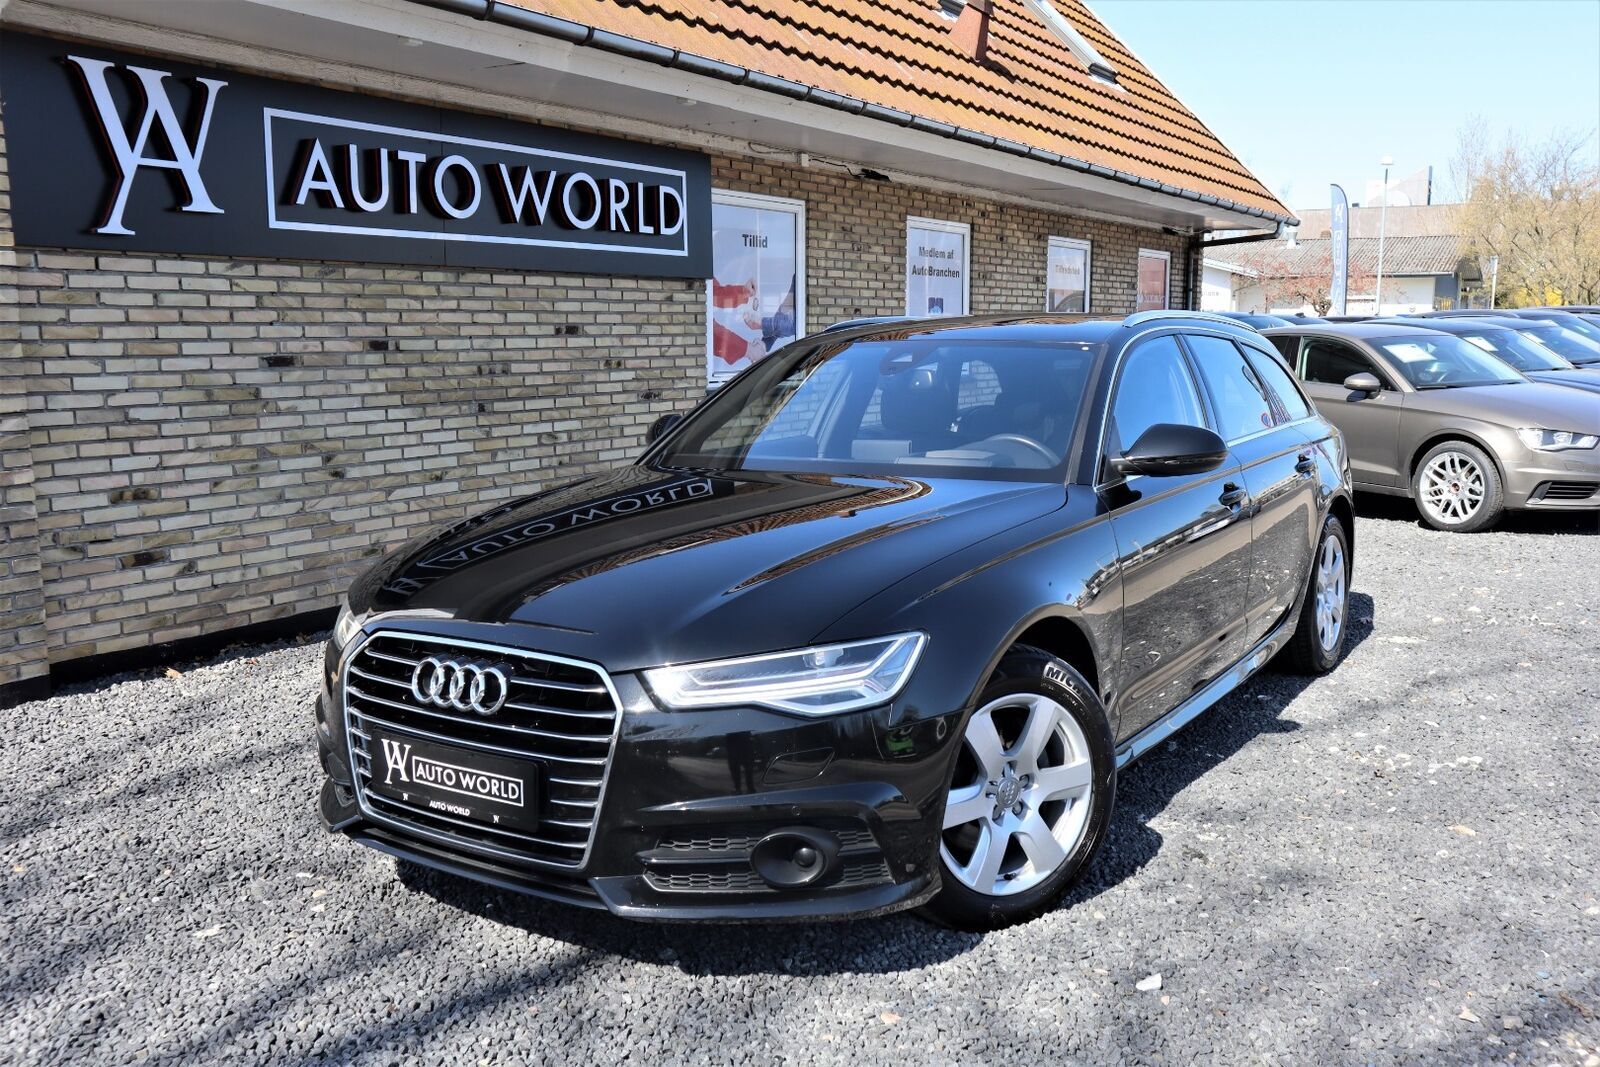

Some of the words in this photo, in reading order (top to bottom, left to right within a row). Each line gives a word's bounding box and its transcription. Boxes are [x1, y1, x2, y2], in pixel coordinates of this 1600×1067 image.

[294, 137, 482, 220] AUTO
[498, 162, 684, 236] WORLD
[741, 233, 768, 249] Tillid
[918, 246, 946, 259] Medlem
[947, 249, 955, 260] af
[911, 265, 960, 279] AutoBranchen
[416, 762, 456, 786] AUTO
[459, 771, 520, 800] WORLD
[429, 800, 447, 811] AUTO
[447, 803, 471, 817] WORLD
